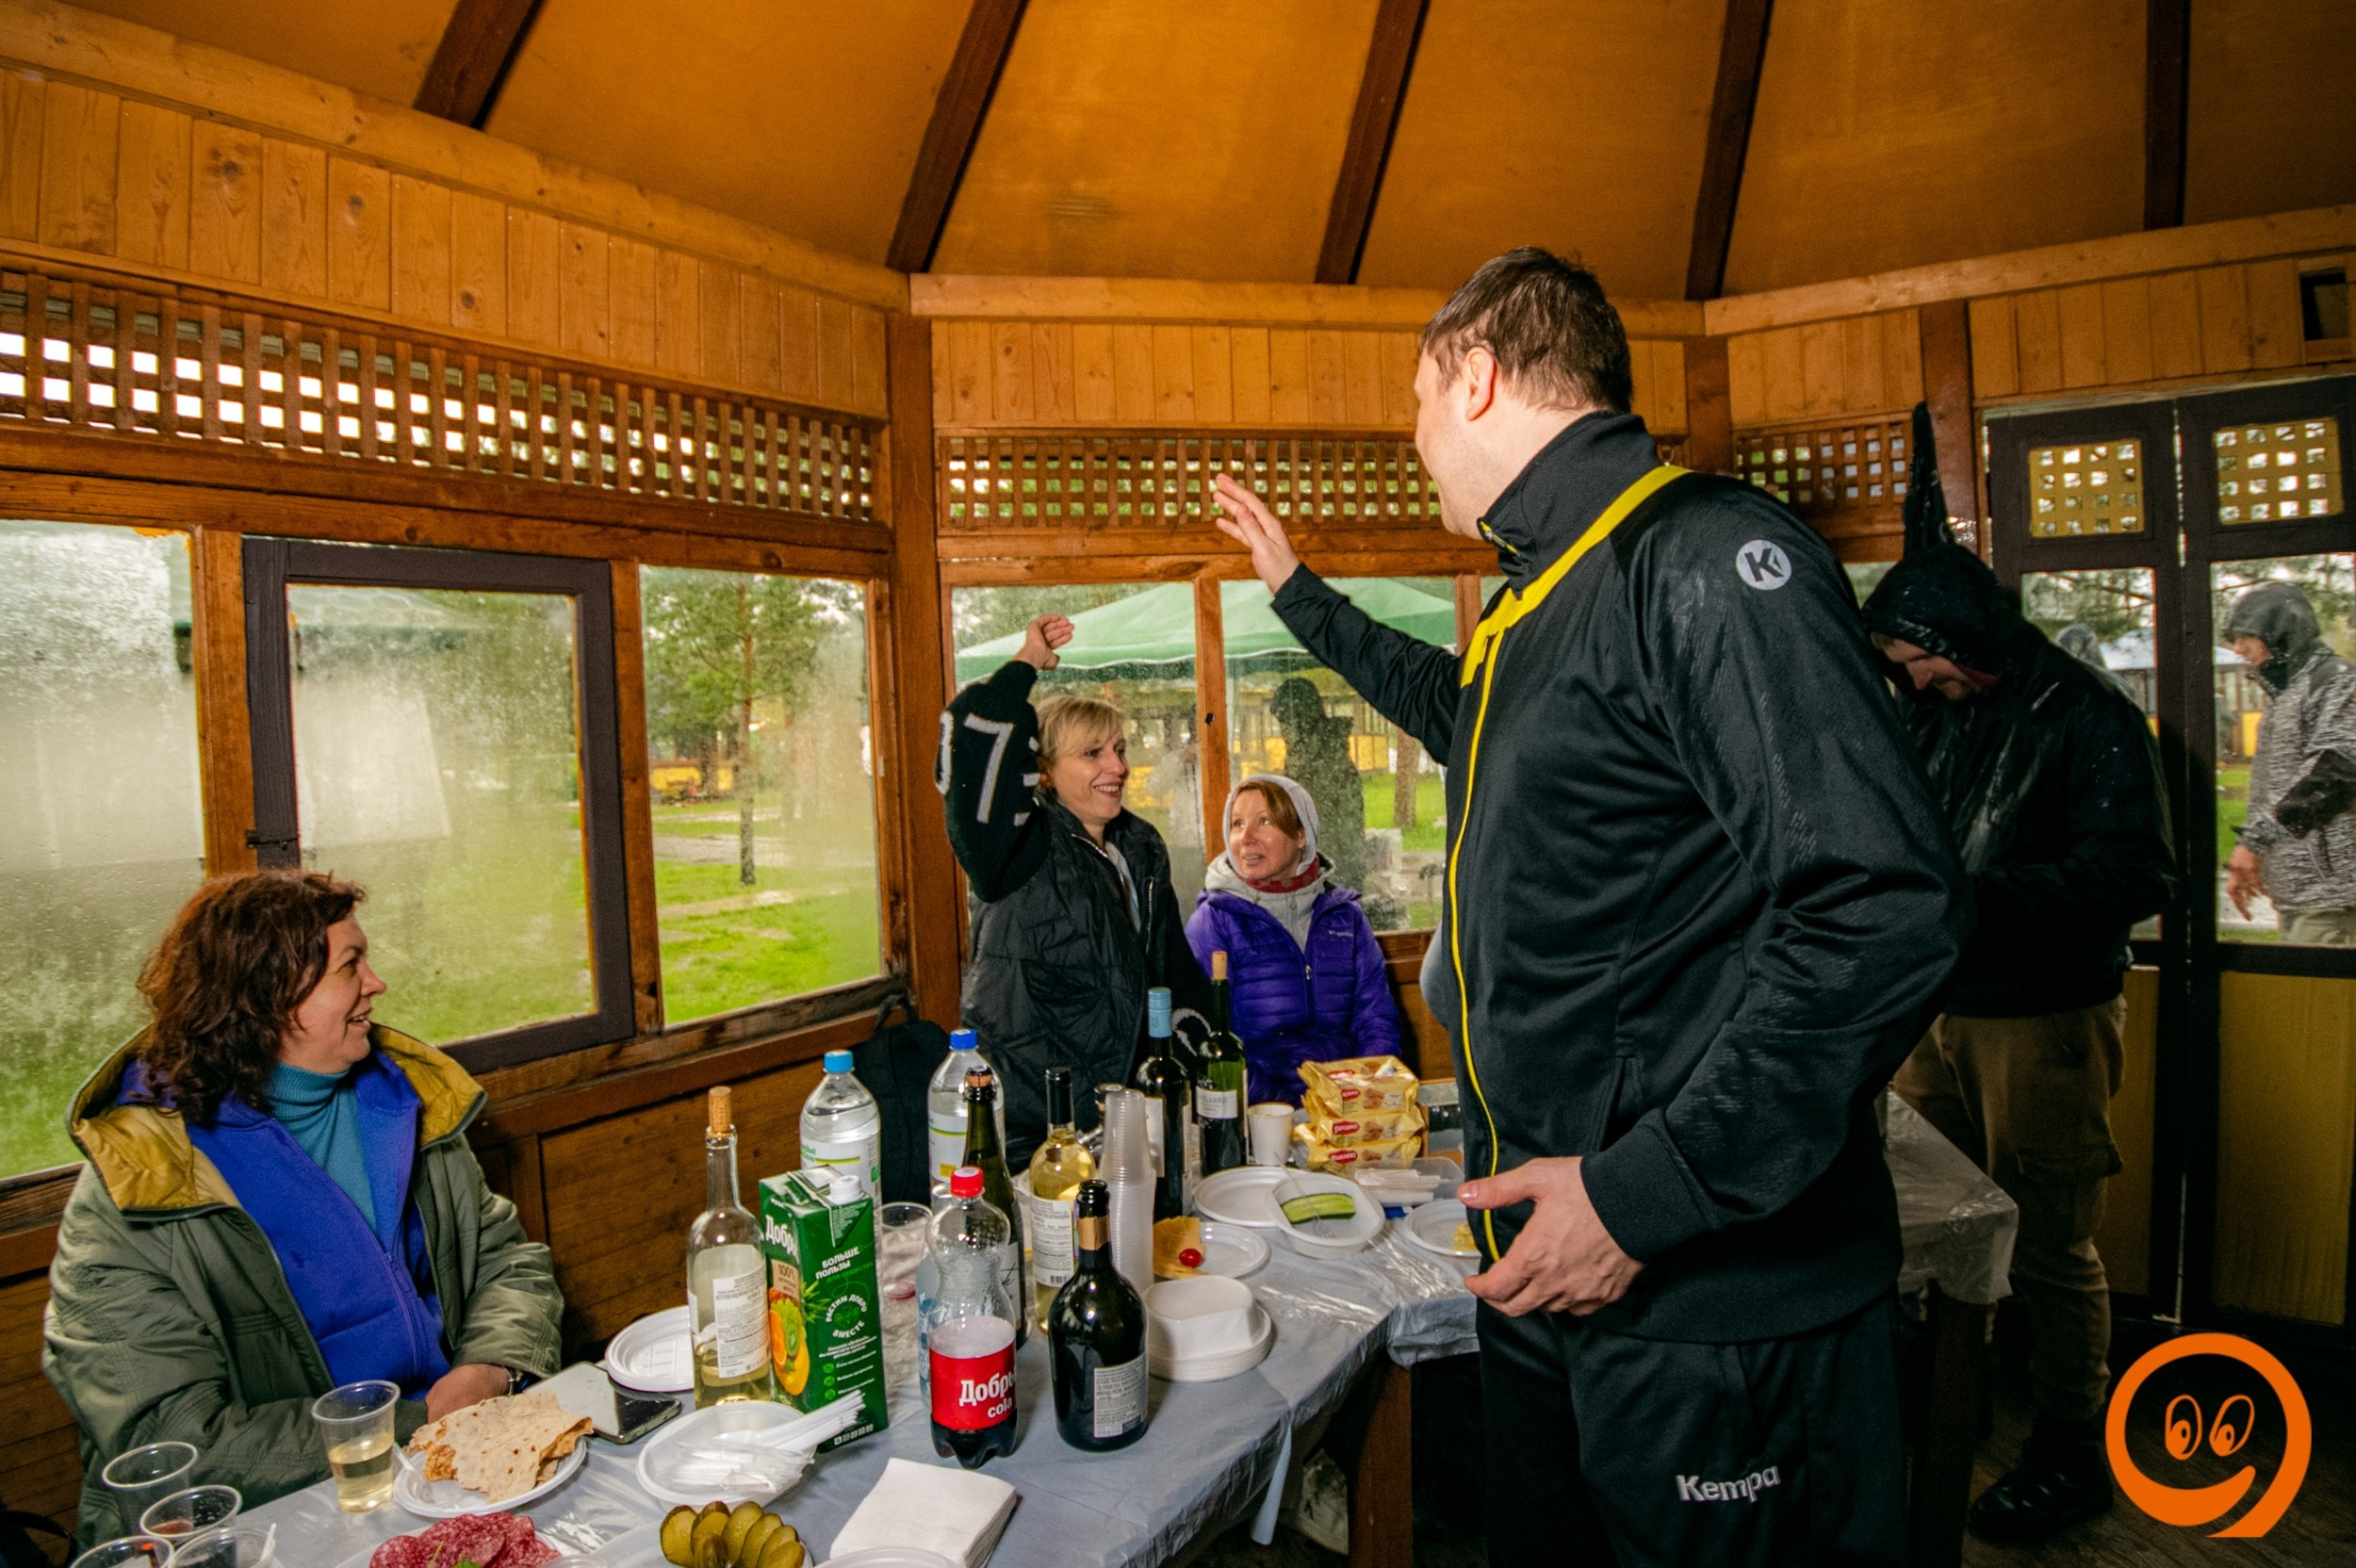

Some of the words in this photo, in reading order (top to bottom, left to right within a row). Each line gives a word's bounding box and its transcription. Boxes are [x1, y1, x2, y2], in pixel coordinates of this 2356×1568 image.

[822, 1246, 860, 1269] БОЛЬШЕ
[815, 1260, 852, 1281] ПОЛЬЗЫ
[826, 1295, 848, 1323] РАСТИМ
[848, 1294, 867, 1313] ДОБРО
[832, 1320, 865, 1338] ВМЕСТЕ
[987, 1396, 1013, 1418] cola
[1676, 1465, 1781, 1503] Kempa
